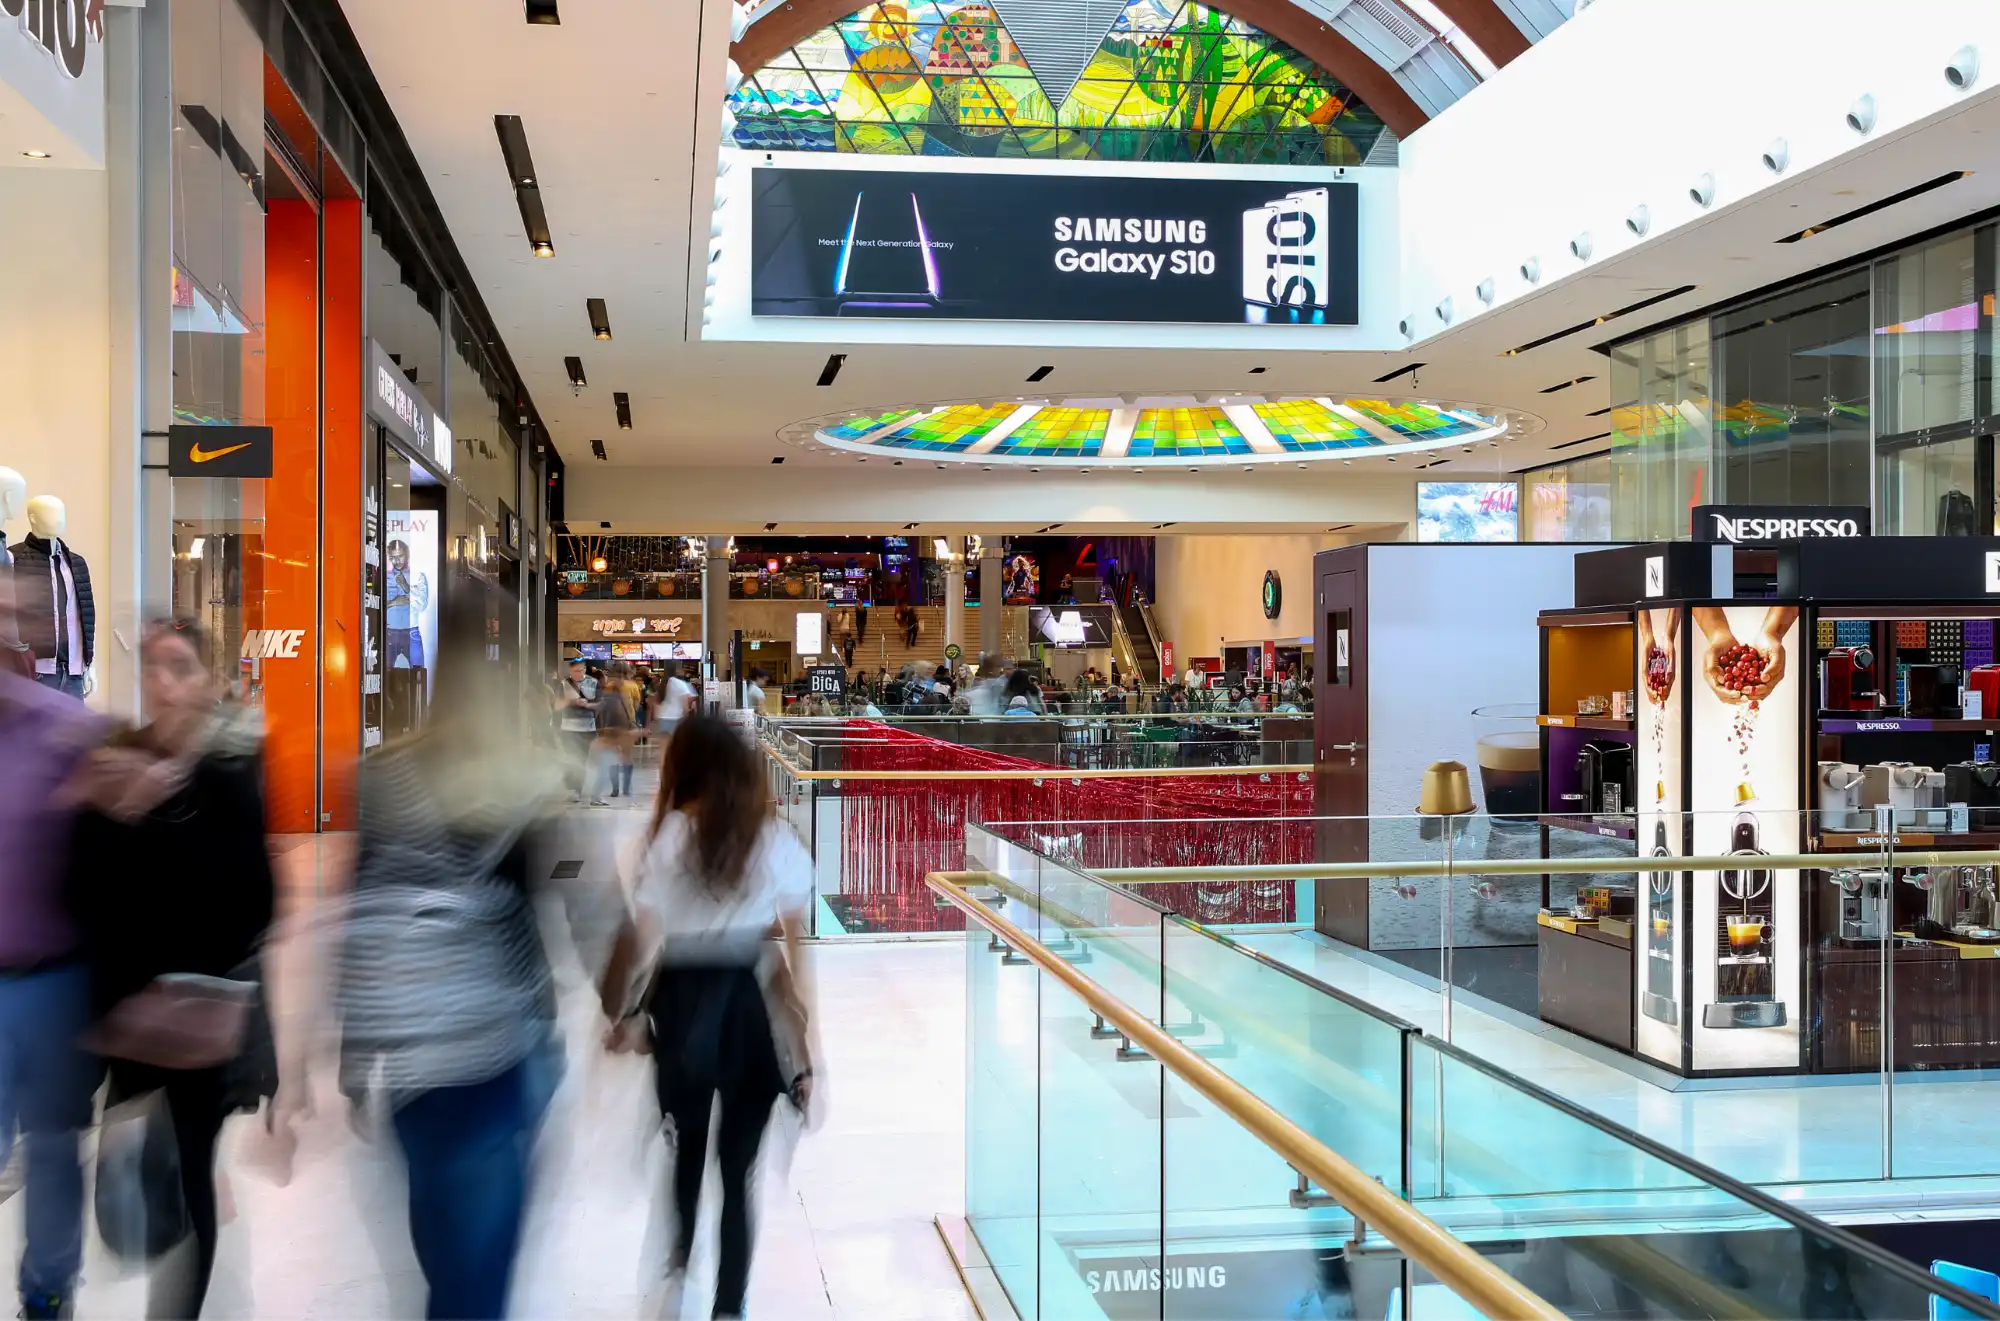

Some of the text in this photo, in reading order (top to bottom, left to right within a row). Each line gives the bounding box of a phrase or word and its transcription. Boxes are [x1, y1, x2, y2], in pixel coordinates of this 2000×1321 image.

[818, 238, 839, 246] Meet
[856, 239, 876, 247] Next
[1054, 216, 1206, 244] SAMSUNG
[1054, 247, 1216, 280] Galaxy S10
[1480, 490, 1514, 513] H&M
[385, 519, 429, 533] EPLAY
[241, 629, 306, 658] NIKE
[1086, 1266, 1176, 1294] SAMSUNG
